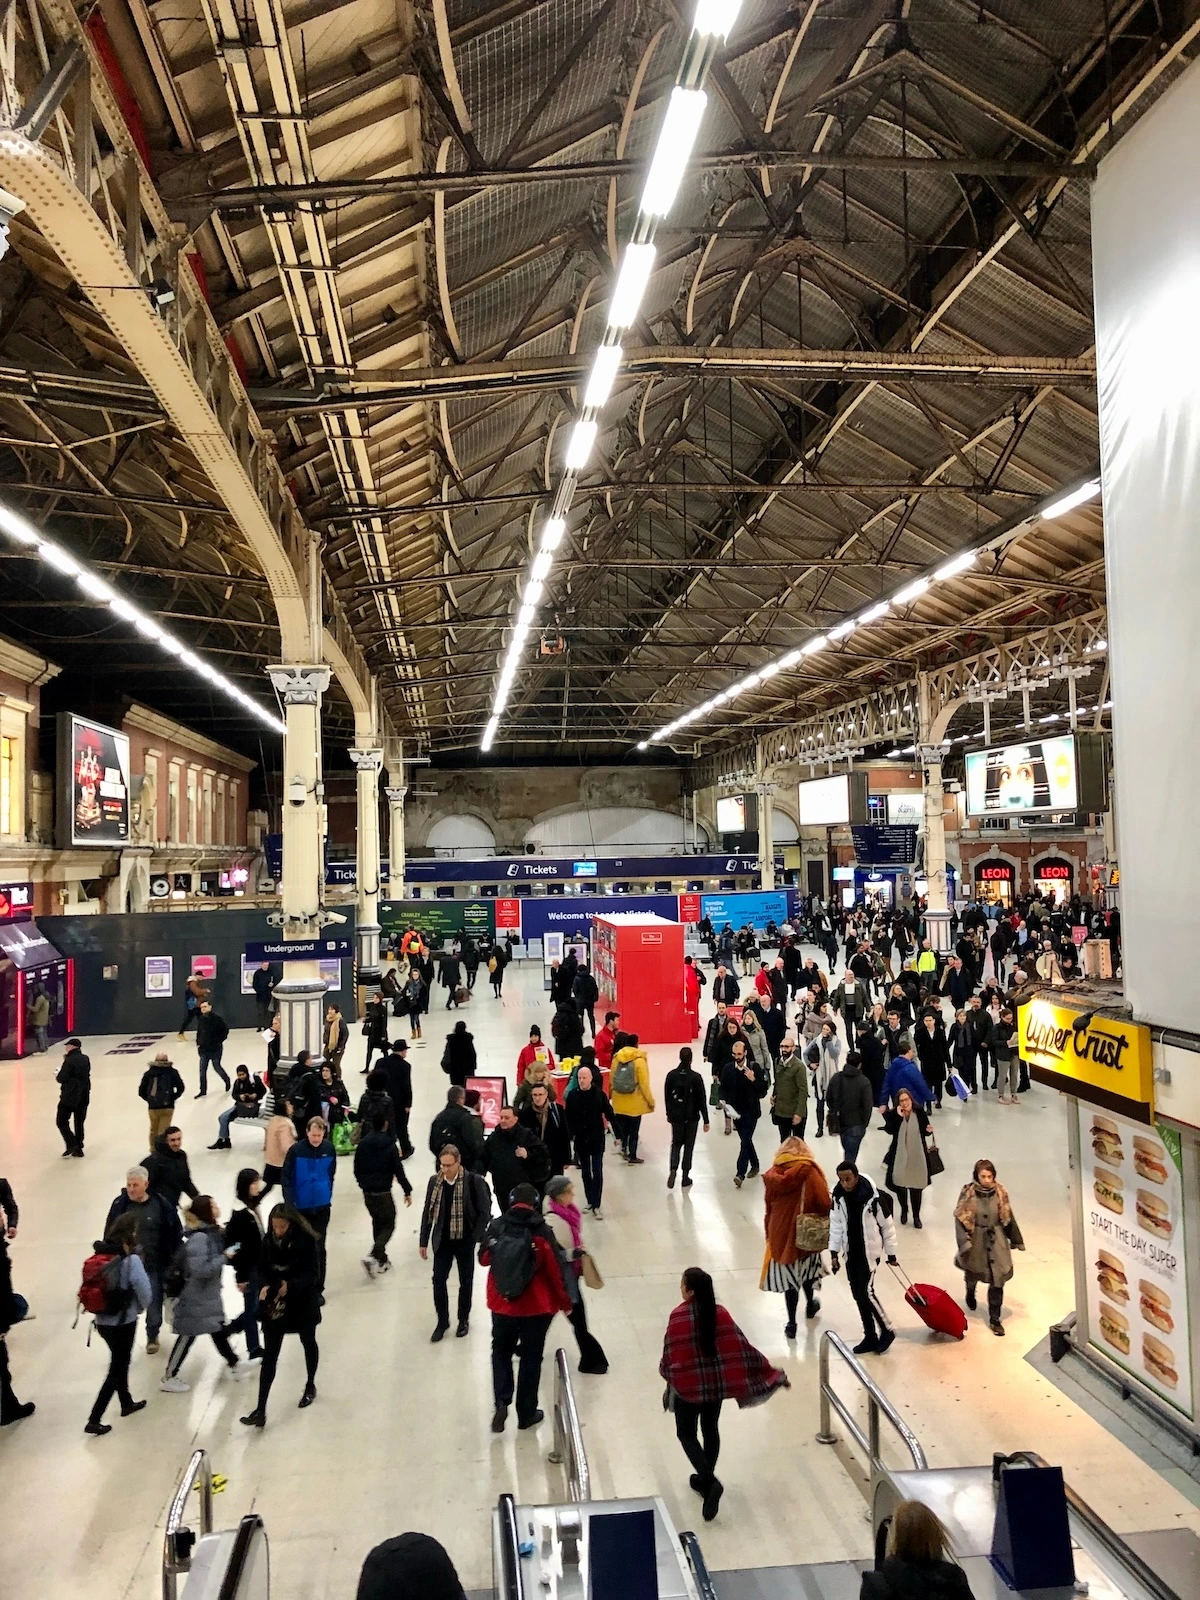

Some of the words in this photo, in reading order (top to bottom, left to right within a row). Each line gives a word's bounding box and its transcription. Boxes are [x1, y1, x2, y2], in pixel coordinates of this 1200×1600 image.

[523, 865, 558, 874] Tickets
[982, 868, 1010, 879] LEON
[1041, 867, 1069, 878] LEON
[548, 911, 584, 920] Welcome
[585, 911, 594, 919] to
[264, 943, 315, 953] Underground
[1026, 1012, 1073, 1056] Upper
[1073, 1028, 1129, 1070] Crust
[1091, 1211, 1112, 1235] START
[1114, 1224, 1129, 1245] THE
[1131, 1233, 1147, 1255] DAY
[1149, 1244, 1177, 1272] SUPER
